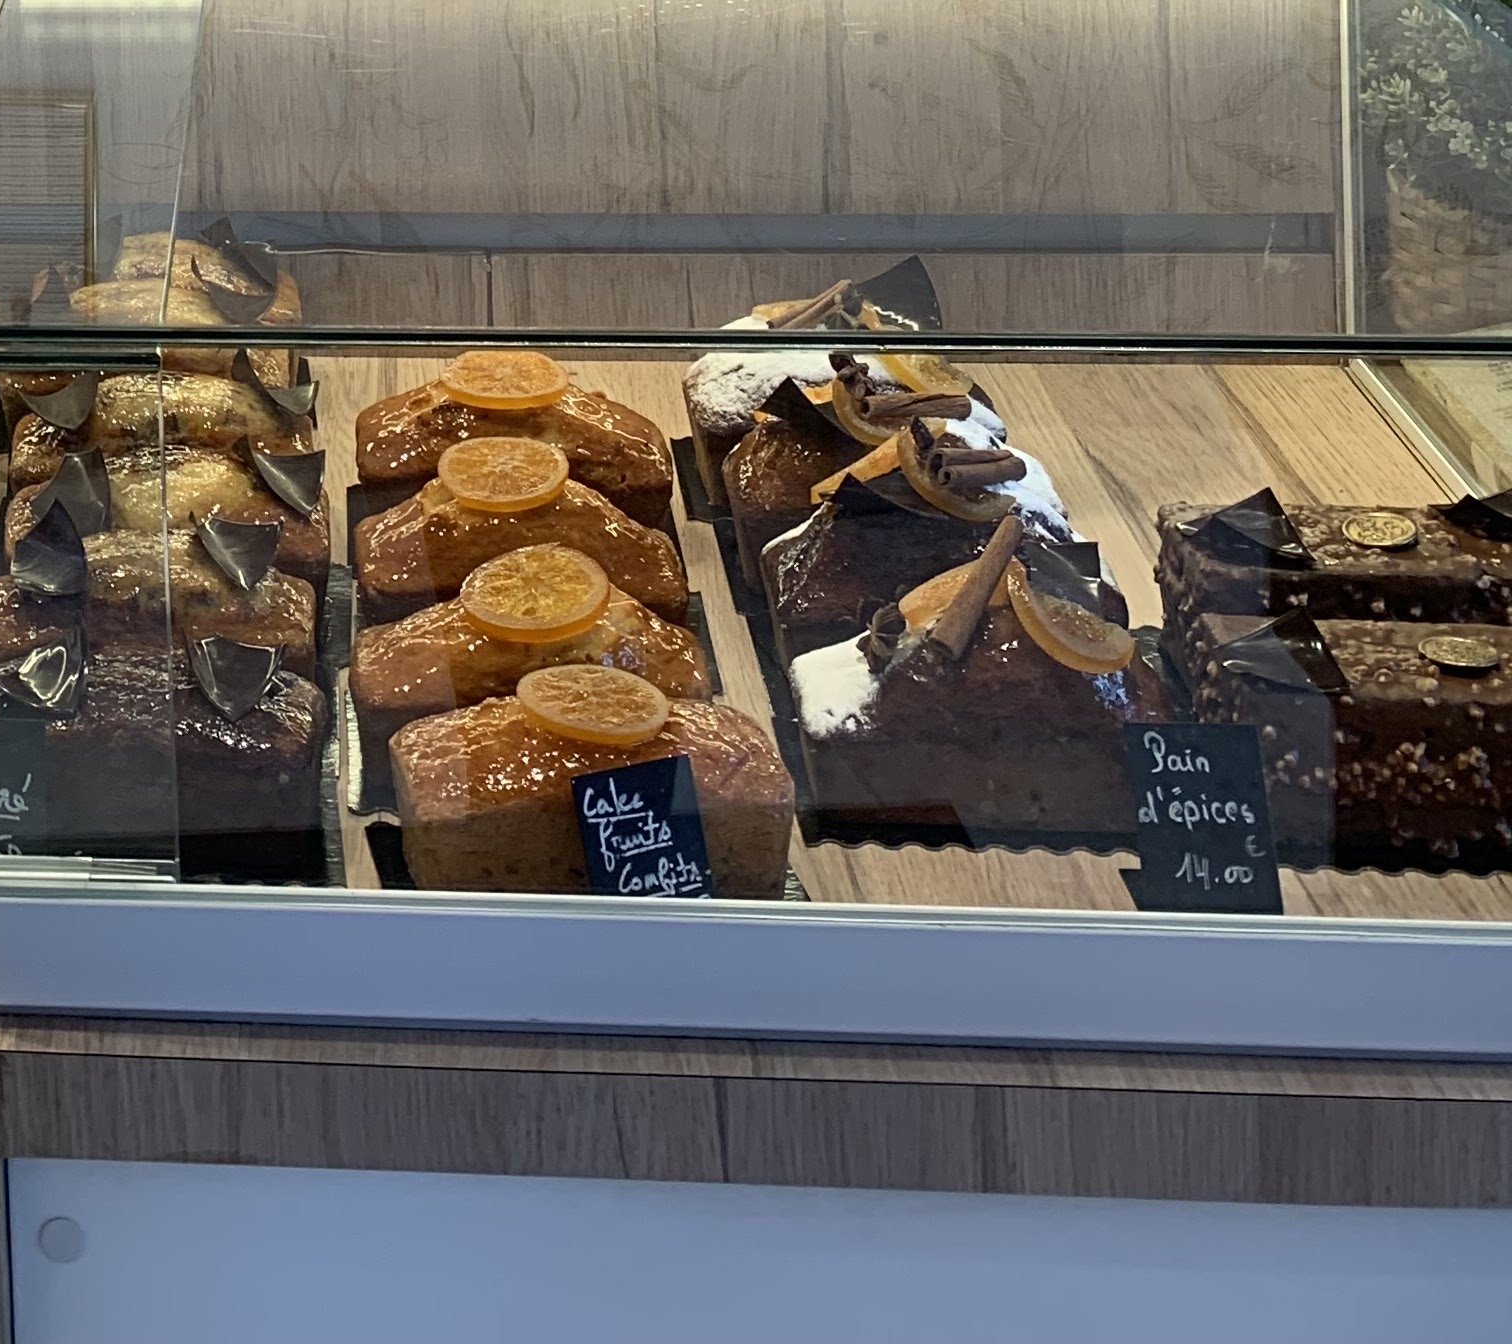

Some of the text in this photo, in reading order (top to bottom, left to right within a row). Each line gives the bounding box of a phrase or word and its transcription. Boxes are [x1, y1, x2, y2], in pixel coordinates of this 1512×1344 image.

[1144, 731, 1210, 773] Pain
[584, 777, 643, 816] Cake
[1139, 787, 1255, 831] d'épices
[600, 811, 672, 872] fruits
